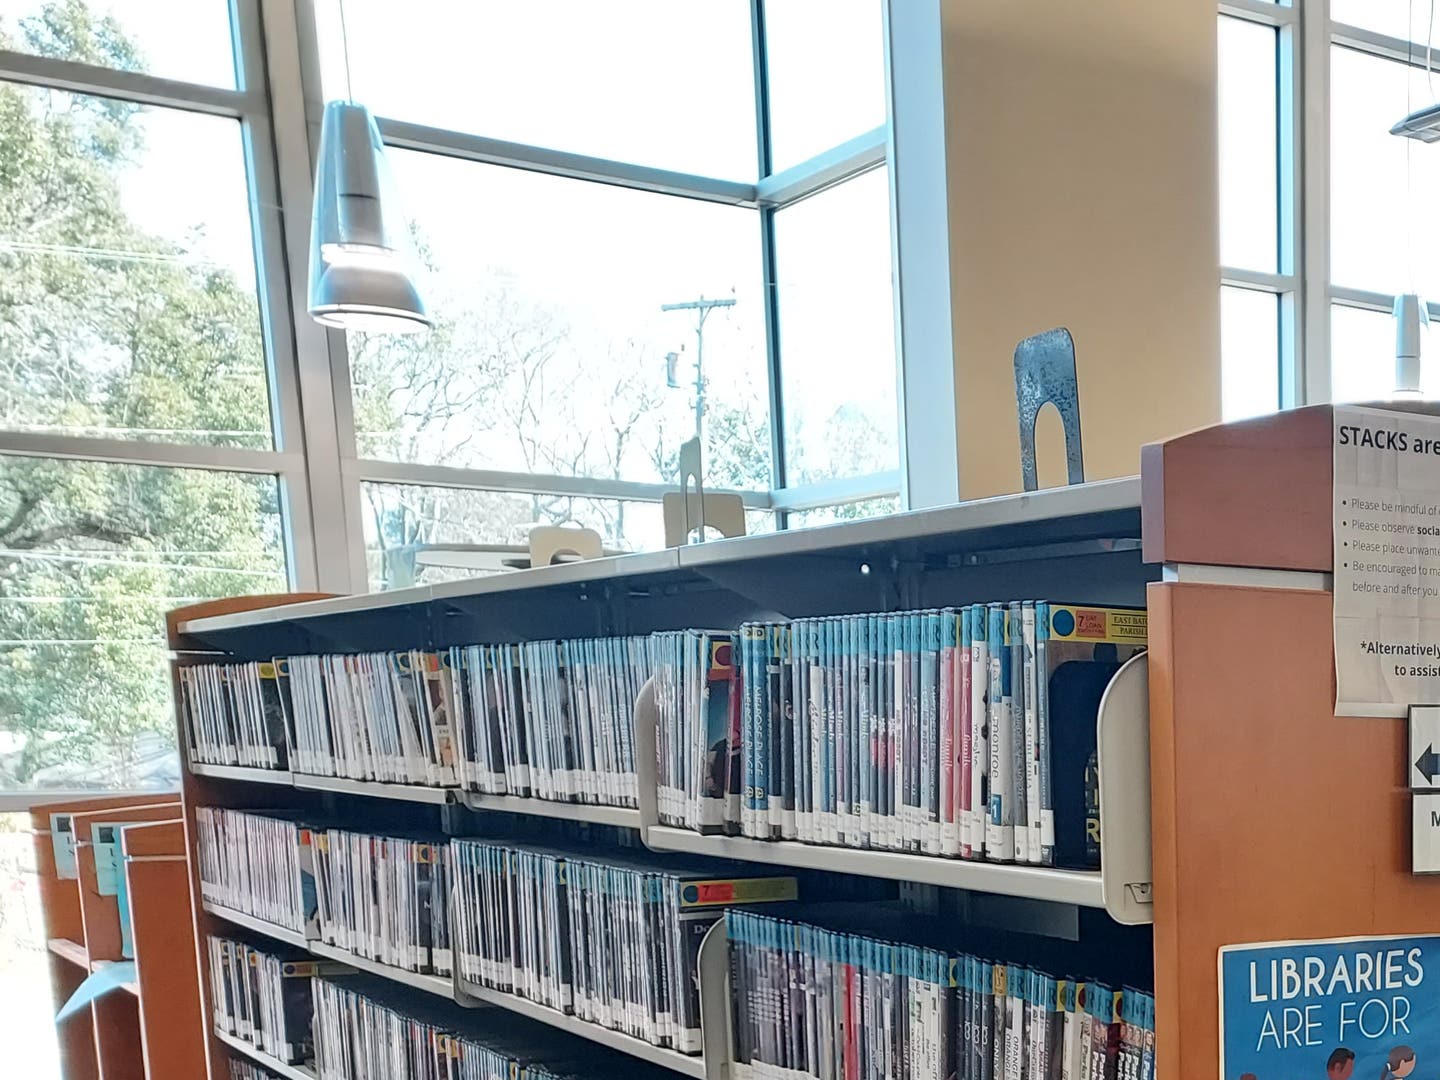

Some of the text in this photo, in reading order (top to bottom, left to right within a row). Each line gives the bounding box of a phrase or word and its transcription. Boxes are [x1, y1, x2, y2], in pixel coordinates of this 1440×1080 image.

[1339, 425, 1408, 452] STACKS
[1351, 498, 1380, 511] Please
[1382, 500, 1393, 512] be
[1394, 502, 1427, 515] mindful
[1428, 505, 1438, 516] of
[1351, 519, 1380, 532] Please
[1381, 521, 1415, 535] observe
[1352, 540, 1381, 553] Please
[1382, 542, 1405, 555] place
[1352, 560, 1365, 572] Be
[1366, 562, 1417, 577] encouraged
[1418, 564, 1428, 576] to
[1352, 581, 1381, 593] before
[1382, 583, 1399, 594] and
[1401, 584, 1421, 596] after
[1422, 586, 1438, 599] you
[1394, 665, 1407, 677] to
[1249, 946, 1425, 1004] LIBRARIES
[1256, 995, 1412, 1052] ARE FOR
